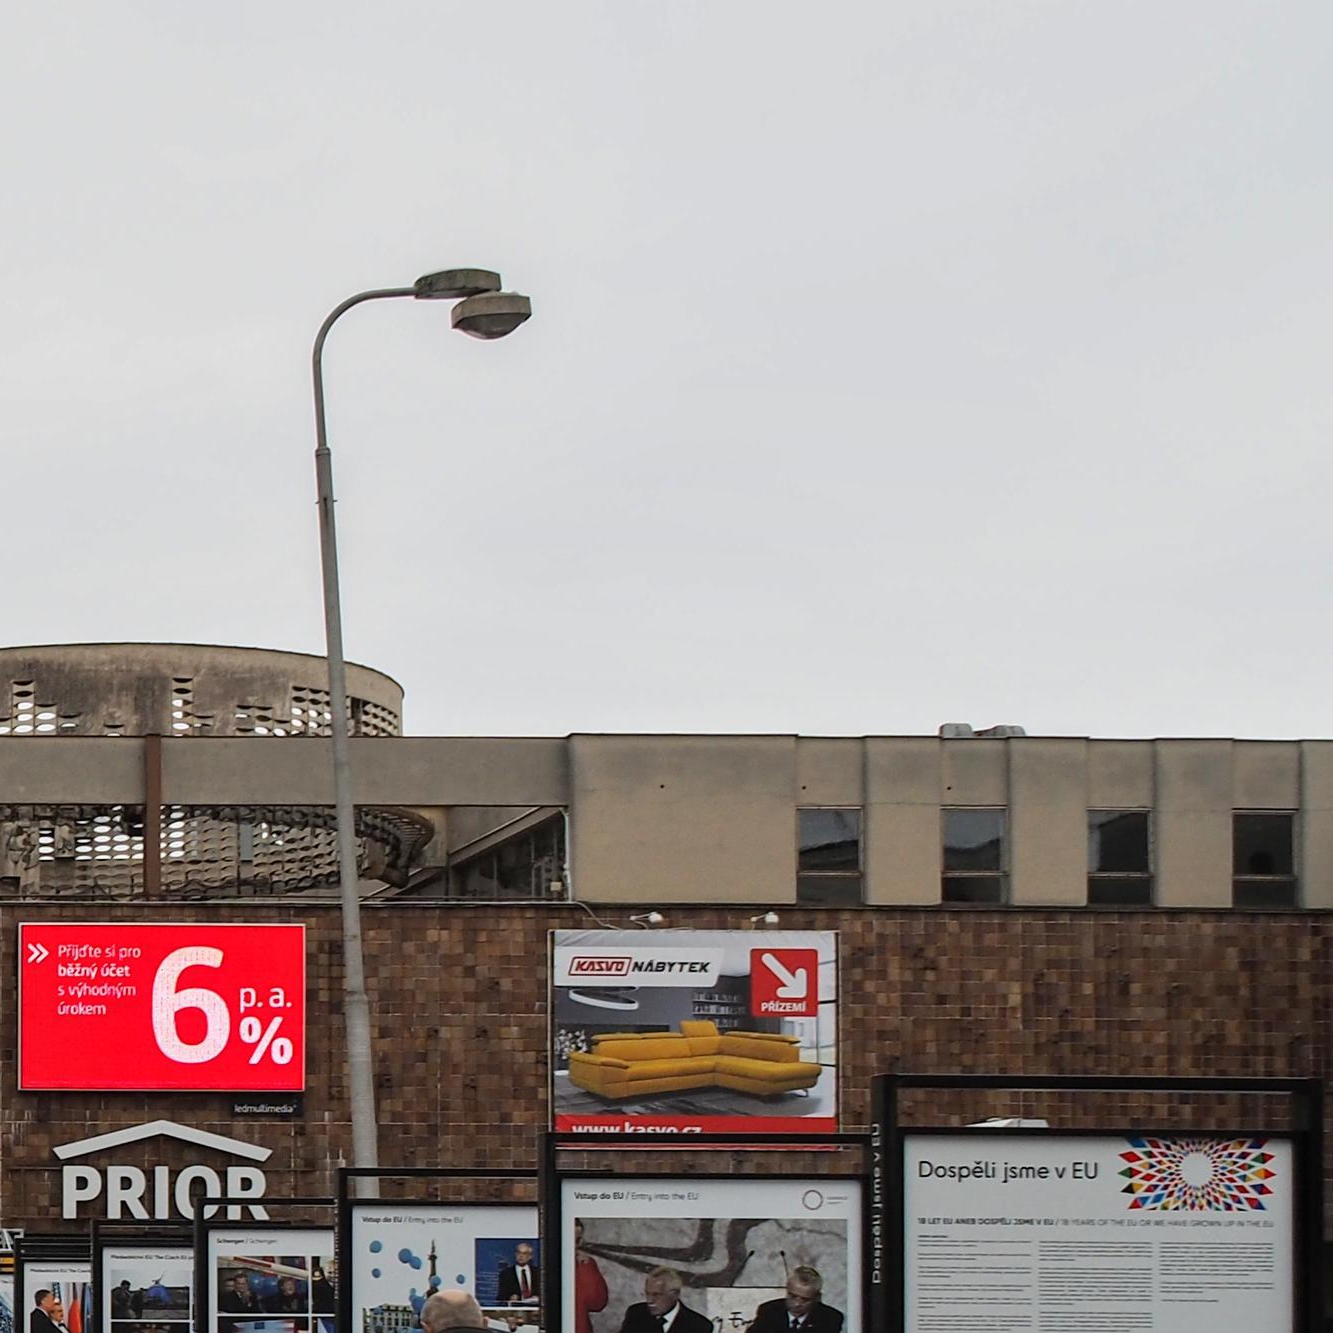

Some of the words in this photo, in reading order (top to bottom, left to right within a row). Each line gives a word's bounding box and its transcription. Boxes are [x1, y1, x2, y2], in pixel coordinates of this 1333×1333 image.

[119, 947, 141, 960] pro
[58, 963, 98, 980] běžný
[101, 963, 131, 977] účet
[575, 960, 624, 972] KASVO
[632, 959, 711, 973] NÁBYTEK
[58, 986, 65, 996] s
[68, 982, 136, 998] výhodným
[58, 1001, 106, 1015] úrokem
[152, 945, 230, 1064] 6
[761, 1000, 806, 1012] PŘÍZEMÍ
[239, 1016, 293, 1065] %
[872, 1123, 881, 1147] EU
[918, 1160, 996, 1183] Dospěli
[1002, 1161, 1050, 1184] jsme
[1055, 1167, 1065, 1180] v
[1073, 1162, 1099, 1180] EU
[62, 1165, 270, 1220] PRIOR
[574, 1192, 598, 1202] Vstup
[600, 1192, 611, 1200] do
[613, 1192, 624, 1200] EU
[631, 1193, 652, 1202] Entry
